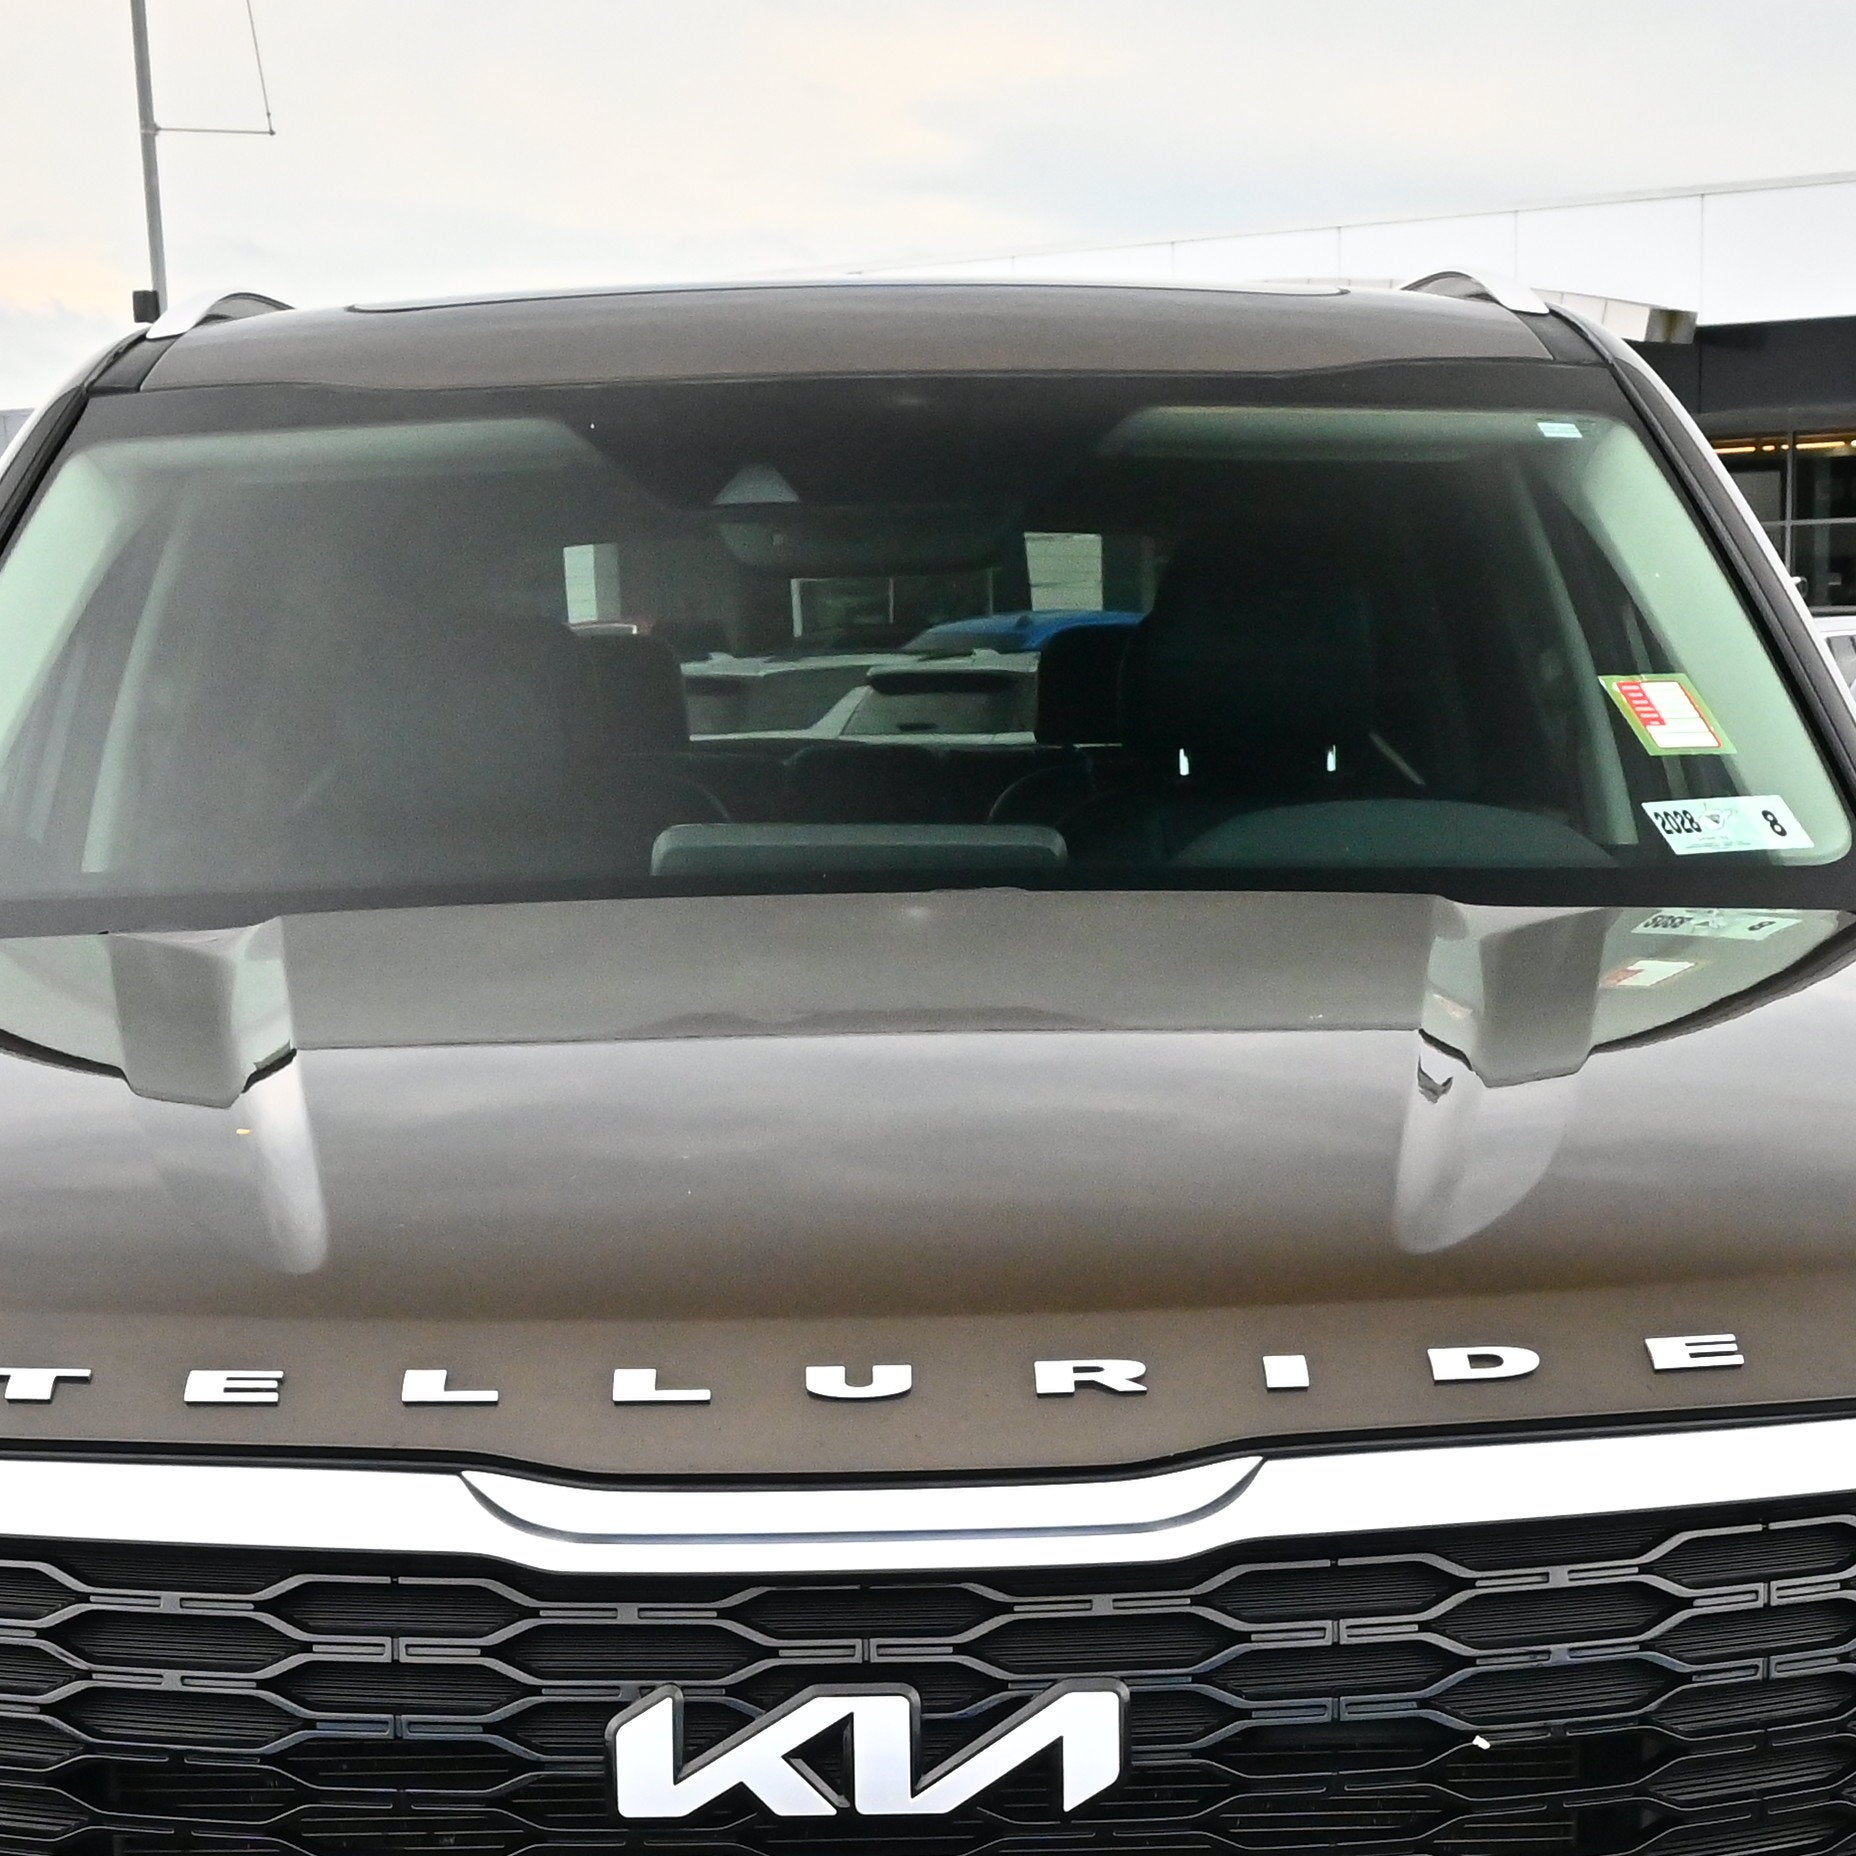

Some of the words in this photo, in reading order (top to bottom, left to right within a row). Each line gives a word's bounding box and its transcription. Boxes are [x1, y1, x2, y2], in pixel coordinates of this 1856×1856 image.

[1653, 809, 1702, 835] 2028
[1761, 809, 1788, 837] 8
[606, 1679, 1129, 1820] KIA
